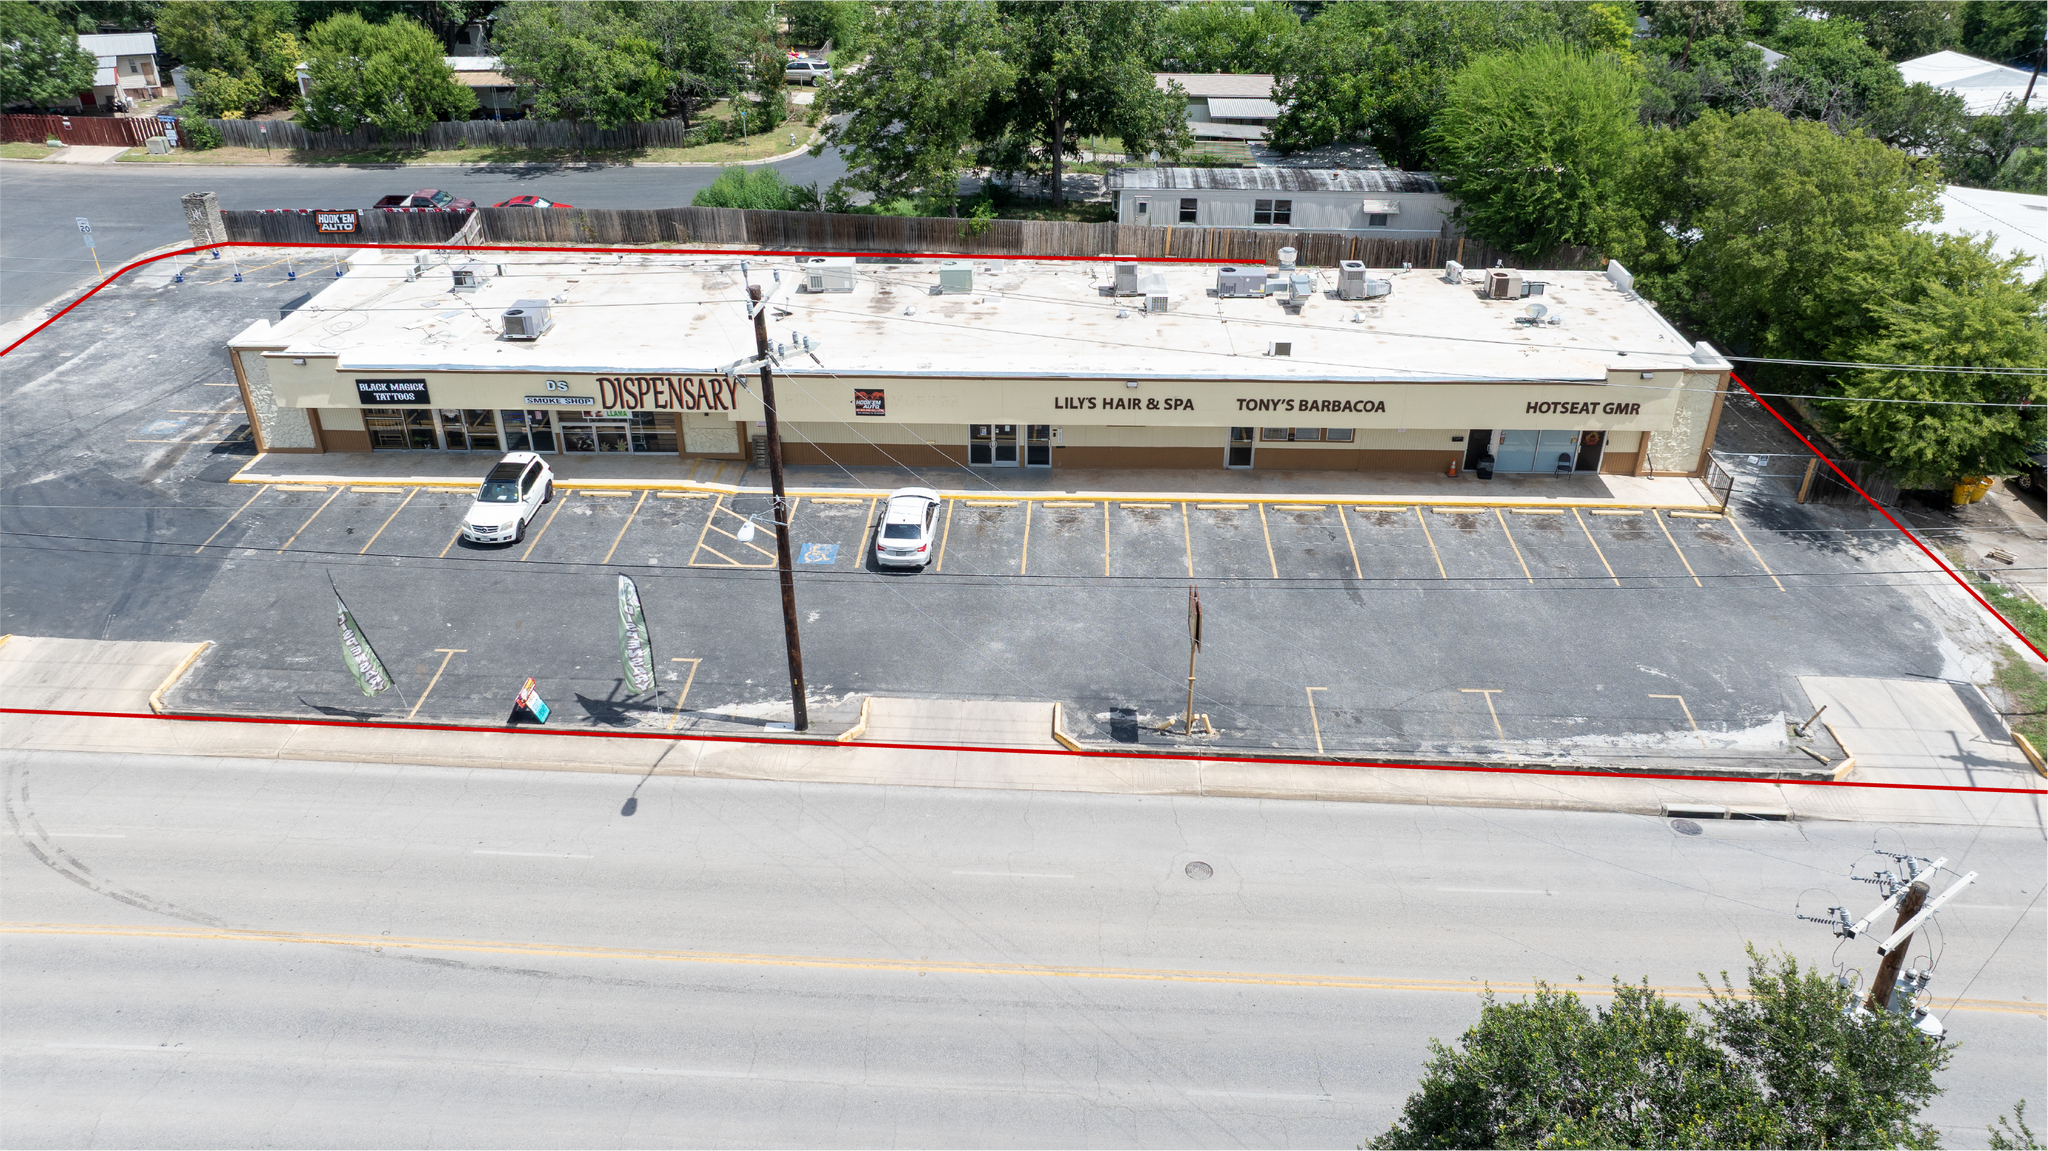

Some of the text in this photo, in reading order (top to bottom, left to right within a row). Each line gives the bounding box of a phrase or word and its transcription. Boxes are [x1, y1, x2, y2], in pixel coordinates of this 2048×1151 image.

[318, 213, 340, 224] HOOK
[321, 223, 353, 231] AUTO
[359, 383, 425, 391] BLACK MAGICK
[546, 379, 569, 392] DS
[373, 392, 415, 401] TATTOOS
[595, 377, 738, 410] DISPENSARY
[1054, 396, 1195, 411] LILY'S HAIR & SPA
[1236, 398, 1386, 413] TONY'S BARBACOA
[1525, 401, 1641, 415] HOTSEAT GMR
